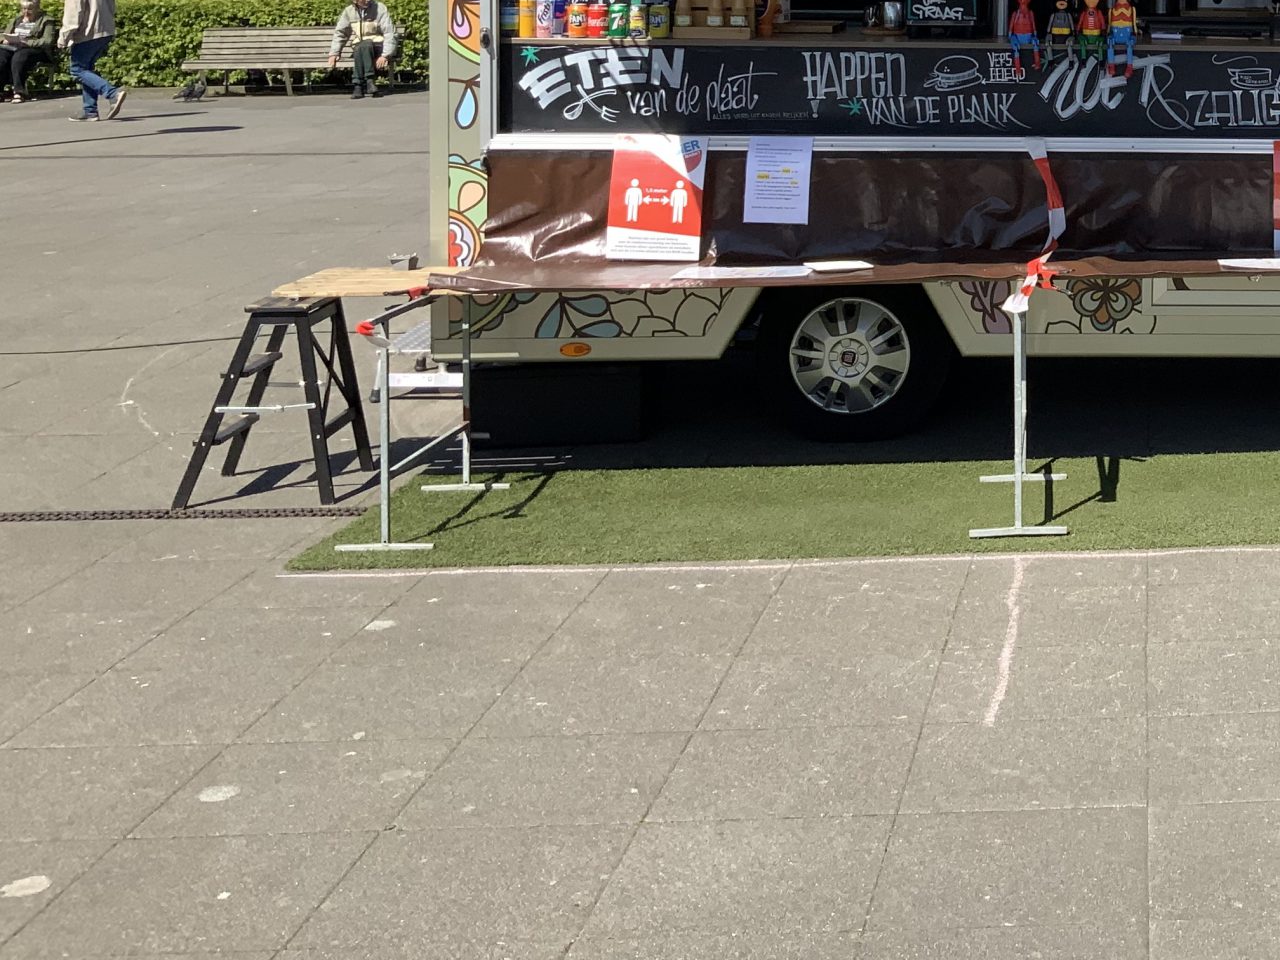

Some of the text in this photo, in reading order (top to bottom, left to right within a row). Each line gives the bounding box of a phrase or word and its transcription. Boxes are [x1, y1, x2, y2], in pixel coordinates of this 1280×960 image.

[912, 4, 964, 20] GRAAG
[518, 48, 686, 110] ETEN
[626, 61, 779, 122] van de plaat
[861, 92, 1032, 131] VAN DE PLANK
